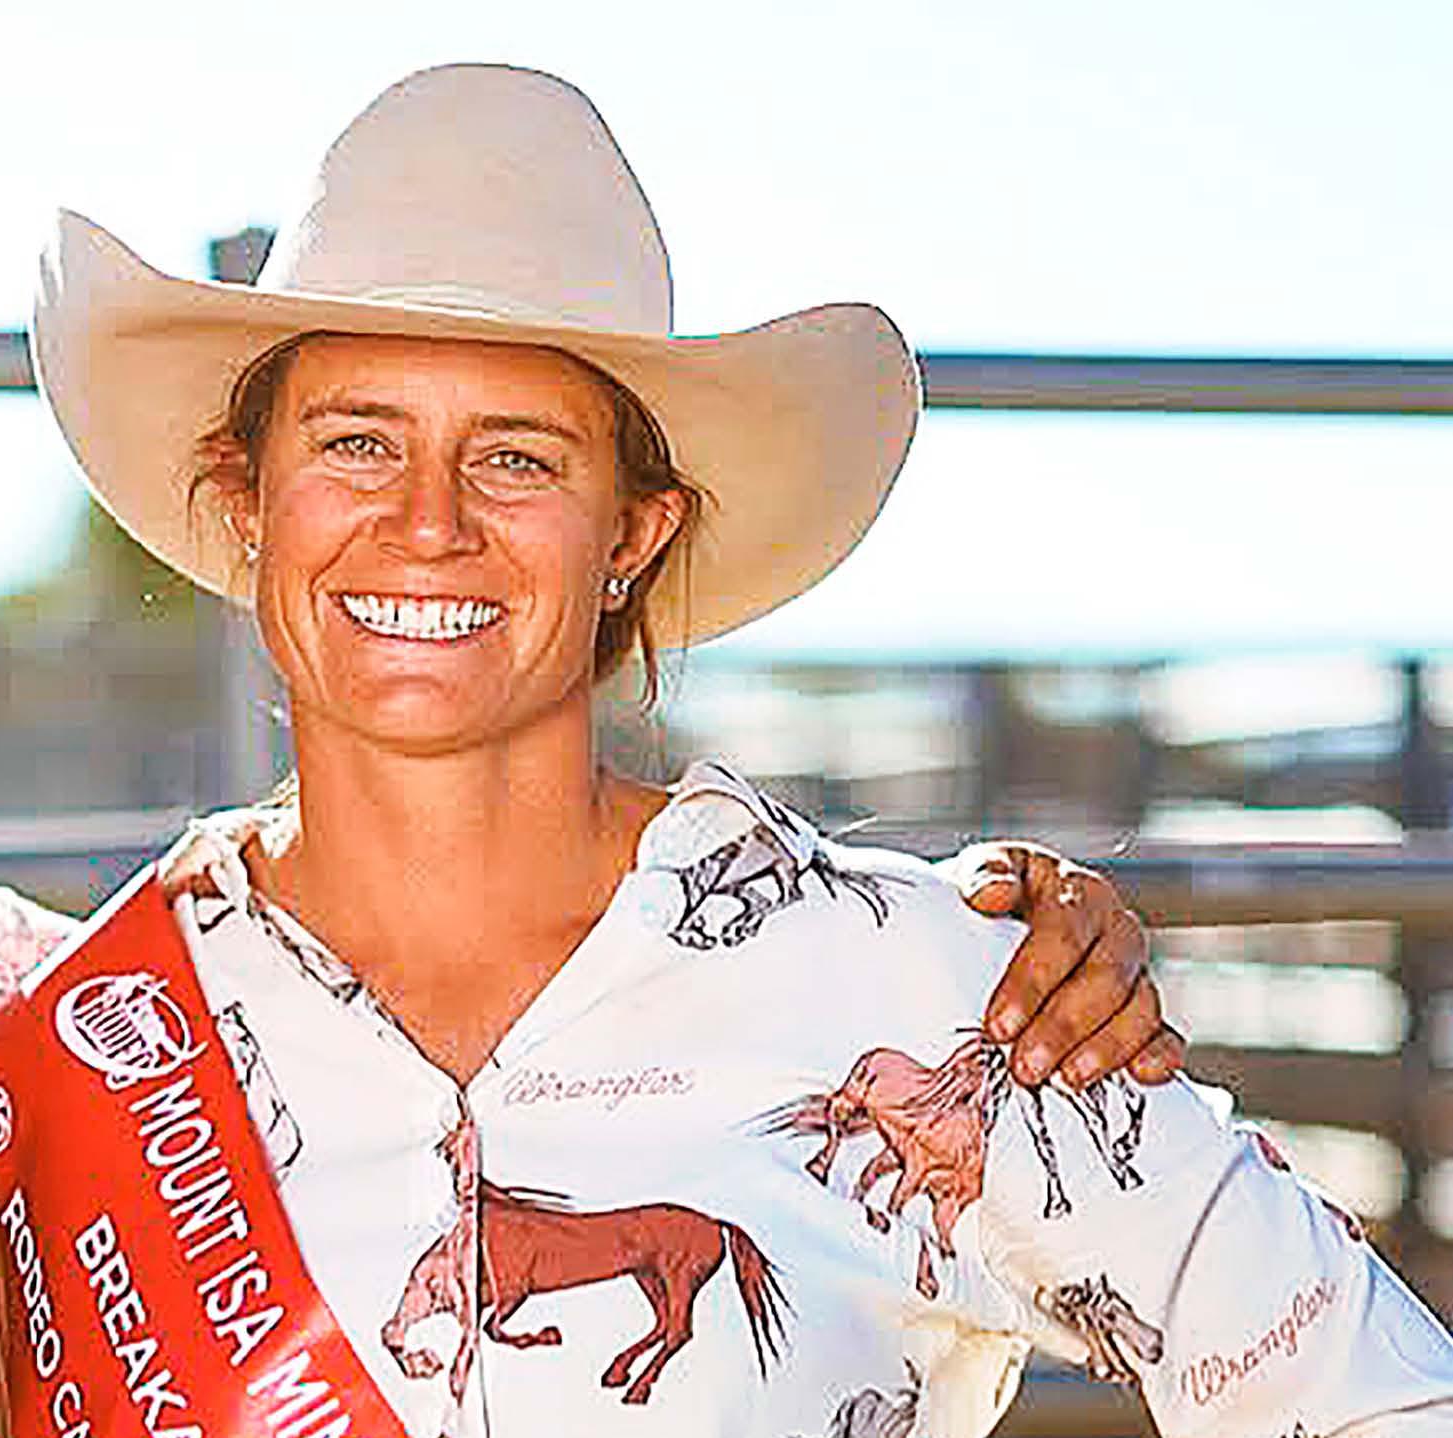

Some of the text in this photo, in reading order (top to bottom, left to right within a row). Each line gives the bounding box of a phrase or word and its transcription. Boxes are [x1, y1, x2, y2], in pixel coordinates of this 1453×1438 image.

[504, 1066, 694, 1110] Wrangler
[1, 1190, 61, 1378] RODEO
[129, 1075, 247, 1262] MOUNT
[198, 1254, 284, 1365] ISA
[1181, 1276, 1337, 1406] Wrangler
